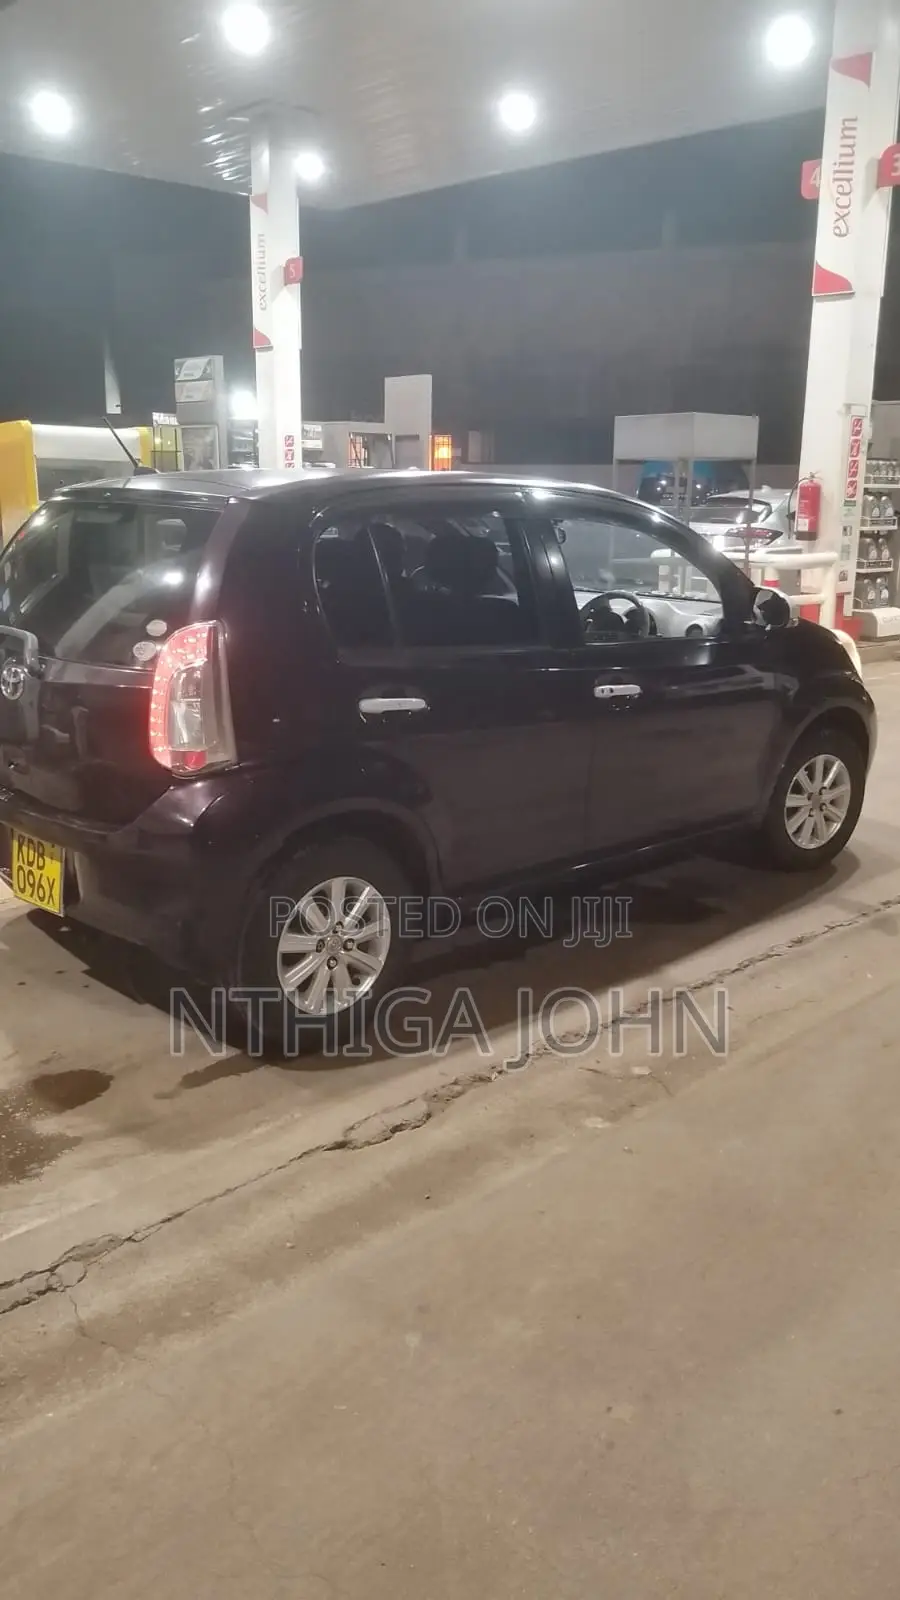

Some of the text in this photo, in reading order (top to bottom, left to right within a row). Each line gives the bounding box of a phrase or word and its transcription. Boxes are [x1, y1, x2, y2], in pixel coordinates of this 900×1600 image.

[809, 166, 821, 188] 4
[832, 115, 858, 238] excellium
[257, 233, 267, 311] excellium
[289, 263, 296, 279] 5
[17, 833, 46, 871] KDB
[16, 864, 56, 907] 096X
